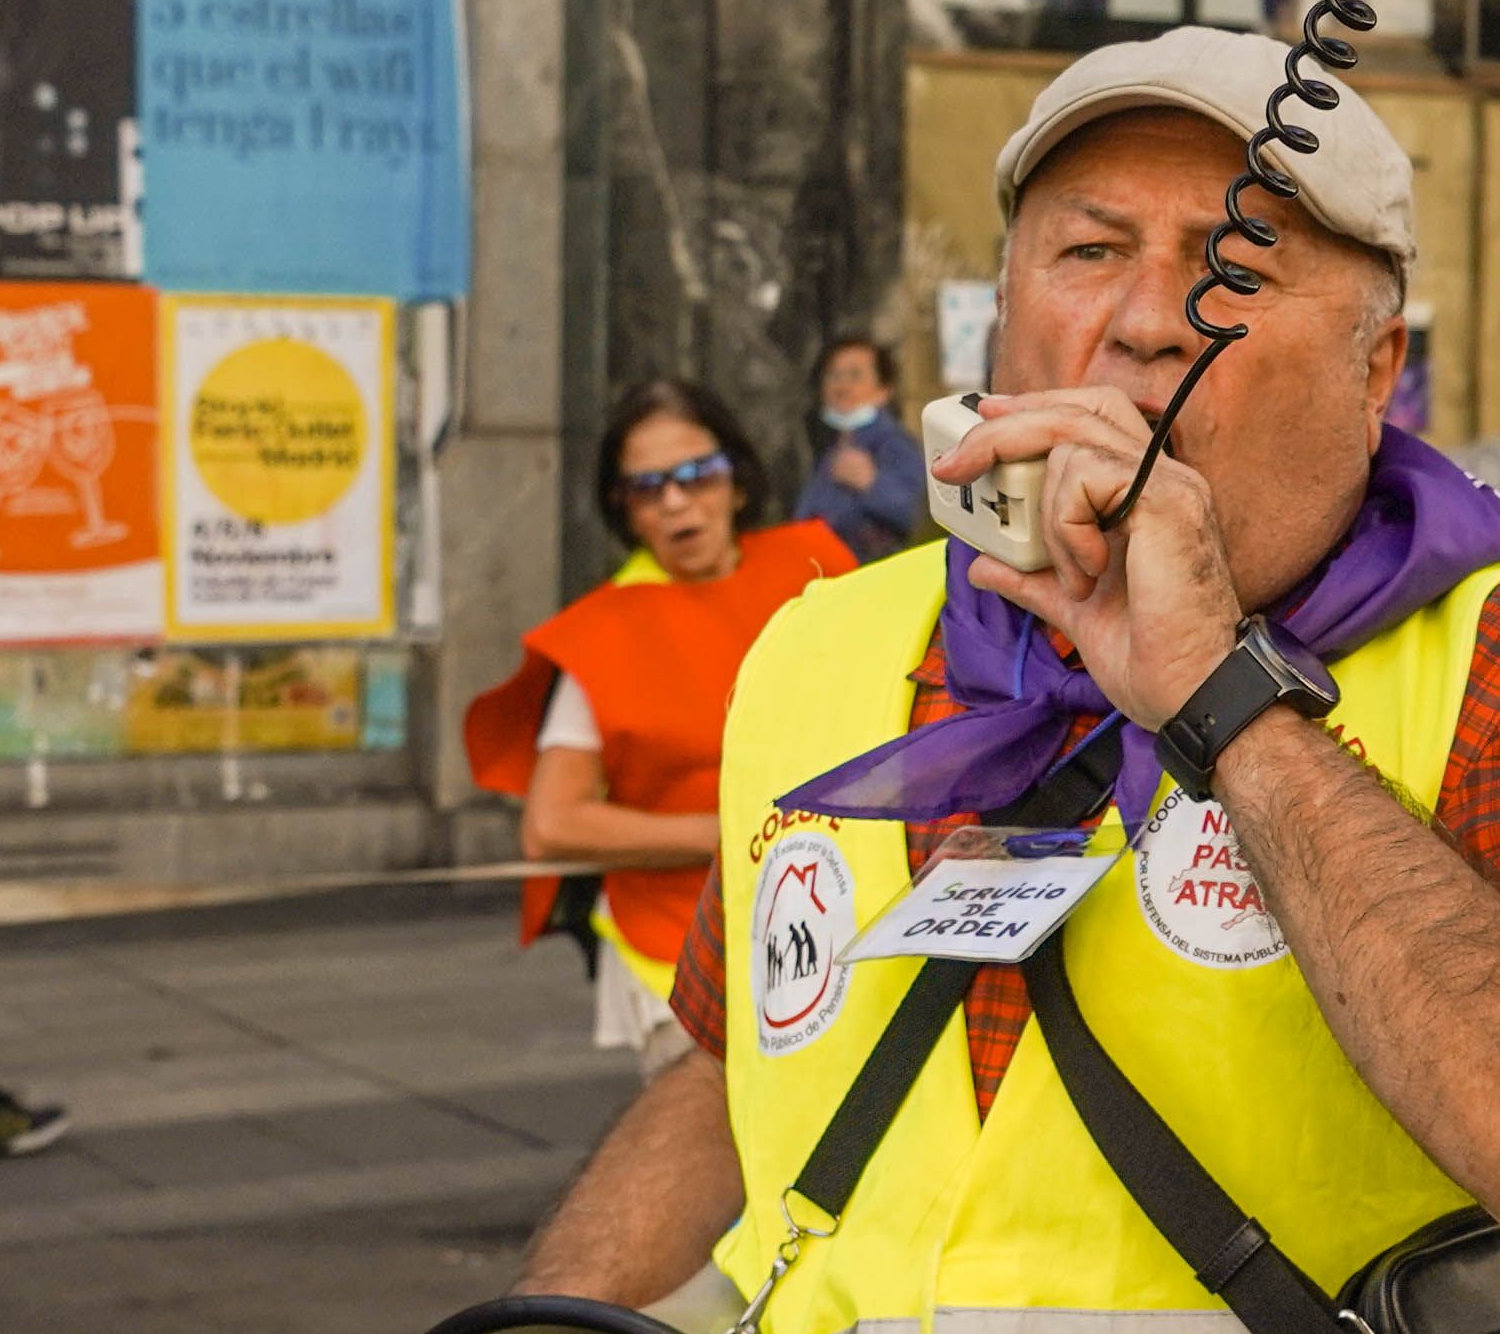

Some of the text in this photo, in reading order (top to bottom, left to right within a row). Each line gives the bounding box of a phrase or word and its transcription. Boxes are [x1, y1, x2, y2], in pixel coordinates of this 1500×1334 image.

[152, 50, 253, 105] que
[263, 43, 311, 91] el
[1140, 851, 1150, 875] POR
[960, 902, 1005, 918] DE
[1142, 892, 1173, 940] DEFENSA
[902, 918, 1030, 939] ORDEN
[1171, 934, 1191, 955] DEL
[1192, 946, 1243, 965] SISTEMA
